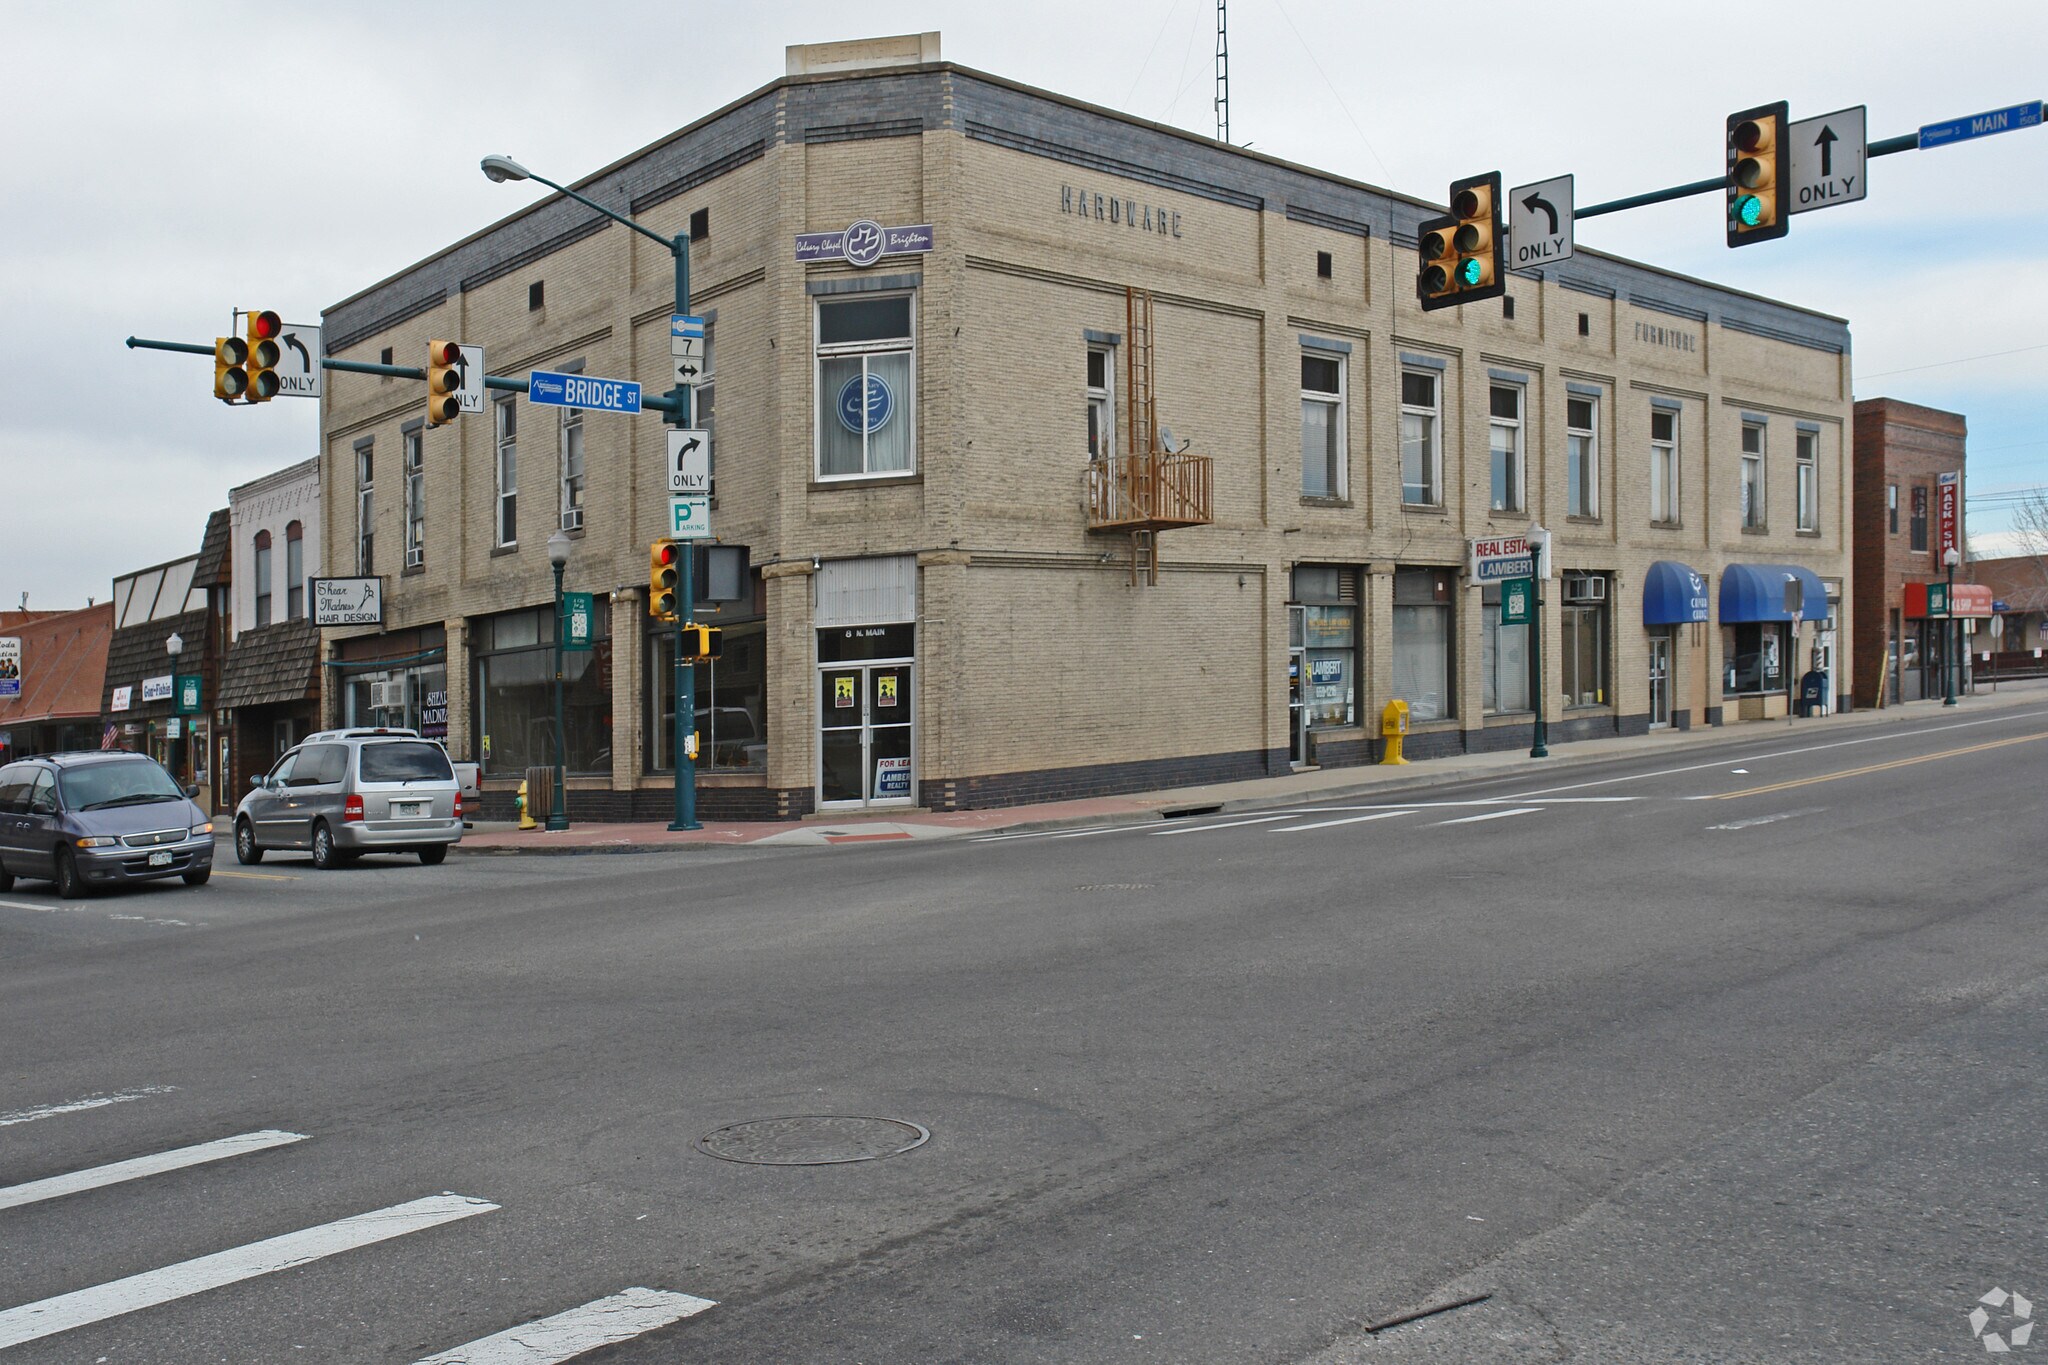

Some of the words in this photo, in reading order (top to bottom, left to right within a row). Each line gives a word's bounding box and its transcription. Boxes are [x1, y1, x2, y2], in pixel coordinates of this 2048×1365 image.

[1972, 112, 2008, 135] MAIN
[1800, 176, 1855, 204] ONLY
[1061, 184, 1183, 238] HARDWARE
[890, 232, 929, 248] Brighton
[1518, 237, 1565, 262] ONLY
[1634, 321, 1696, 353] FURNITURE
[682, 339, 693, 356] 7
[280, 376, 315, 391] ONLY
[455, 393, 479, 407] NLY
[565, 378, 623, 408] BRIDGE
[627, 391, 637, 404] ST
[673, 474, 704, 487] ONLY
[1942, 485, 1954, 519] PACK
[1476, 541, 1502, 557] REAL
[1503, 539, 1531, 555] ESTA
[1480, 560, 1533, 577] LAMBERT
[317, 581, 348, 596] Shear
[319, 597, 355, 612] Madness
[319, 614, 340, 623] HAIR
[344, 612, 378, 622] DESIGN
[845, 629, 853, 638] 8
[865, 628, 885, 637] MAIN
[1312, 660, 1342, 676] LAMBERT
[880, 760, 895, 768] FOR
[898, 759, 911, 767] LEA
[882, 772, 910, 782] LAMBER
